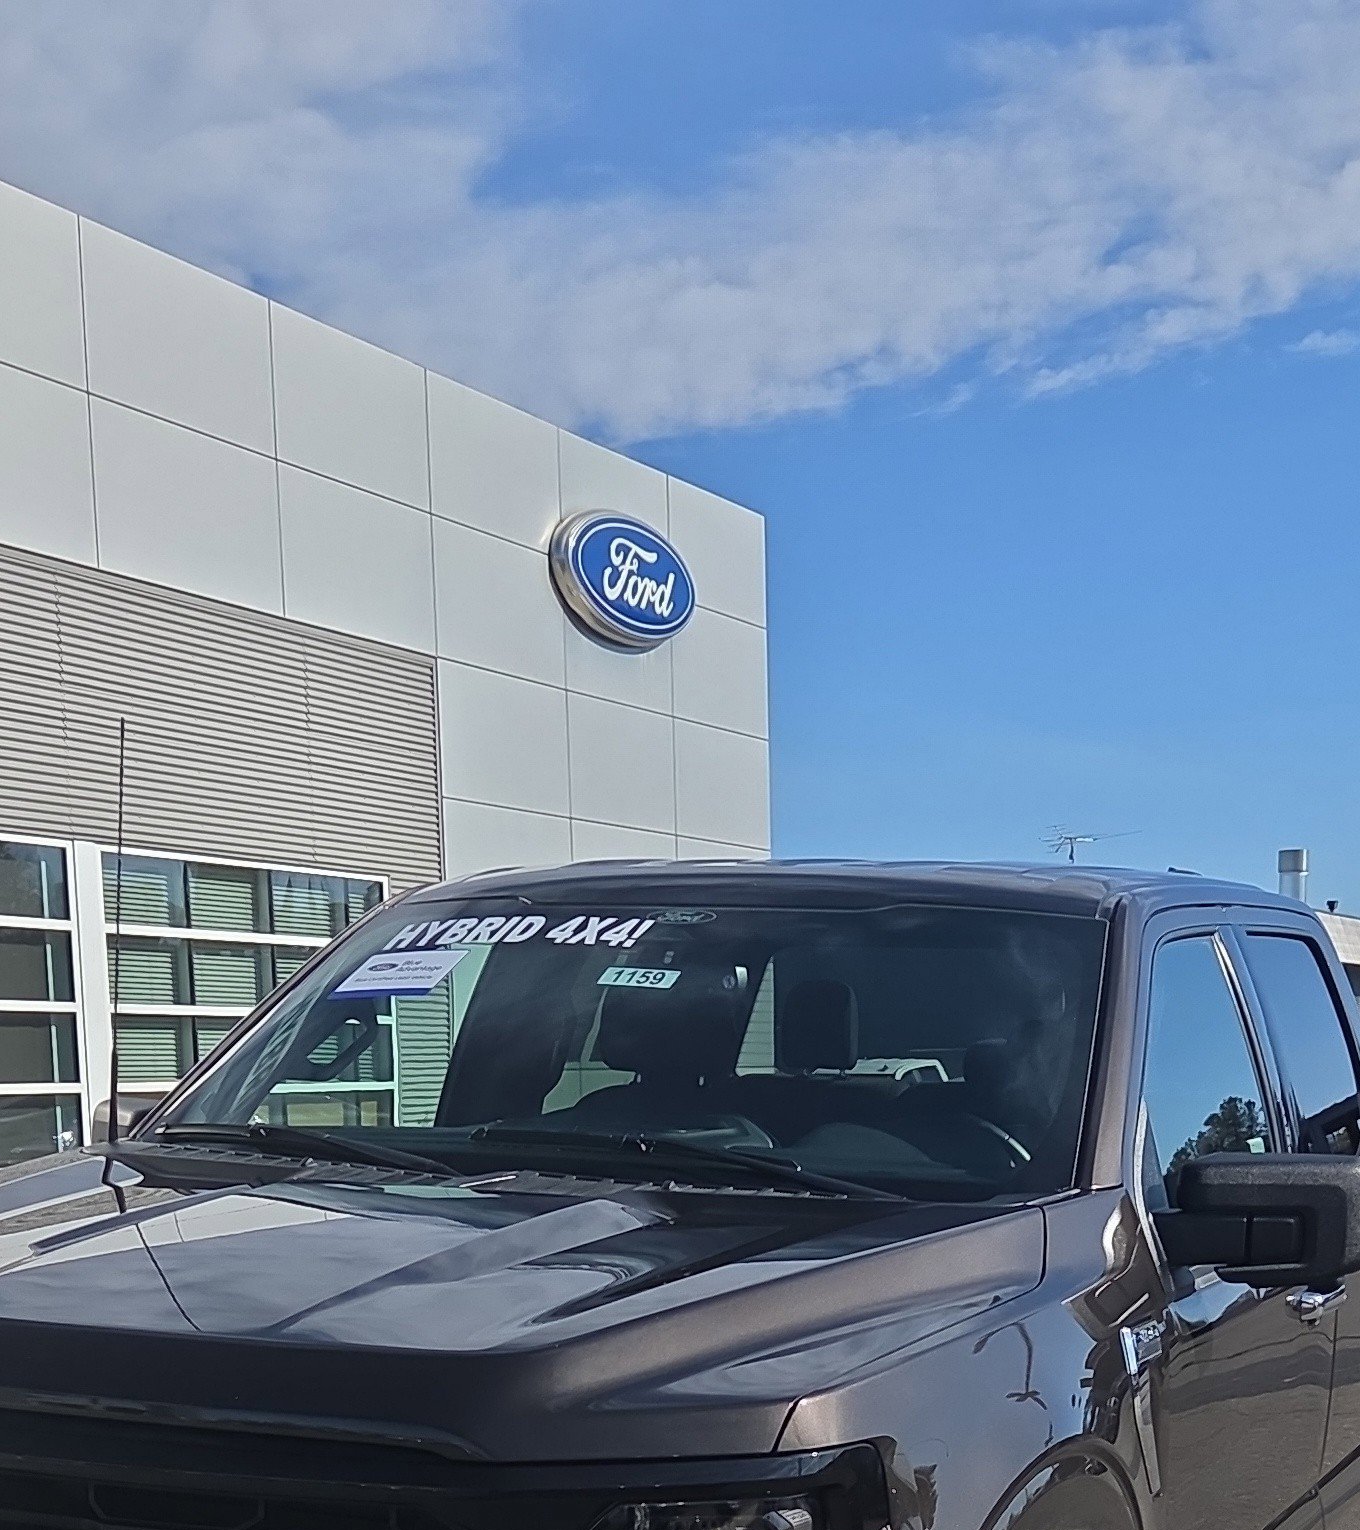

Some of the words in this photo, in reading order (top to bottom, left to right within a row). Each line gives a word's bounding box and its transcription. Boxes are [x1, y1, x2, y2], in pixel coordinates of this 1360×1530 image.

[603, 537, 676, 618] Ford
[383, 916, 547, 950] HYBRID
[545, 916, 656, 948] 4X4!
[613, 969, 666, 985] 1159
